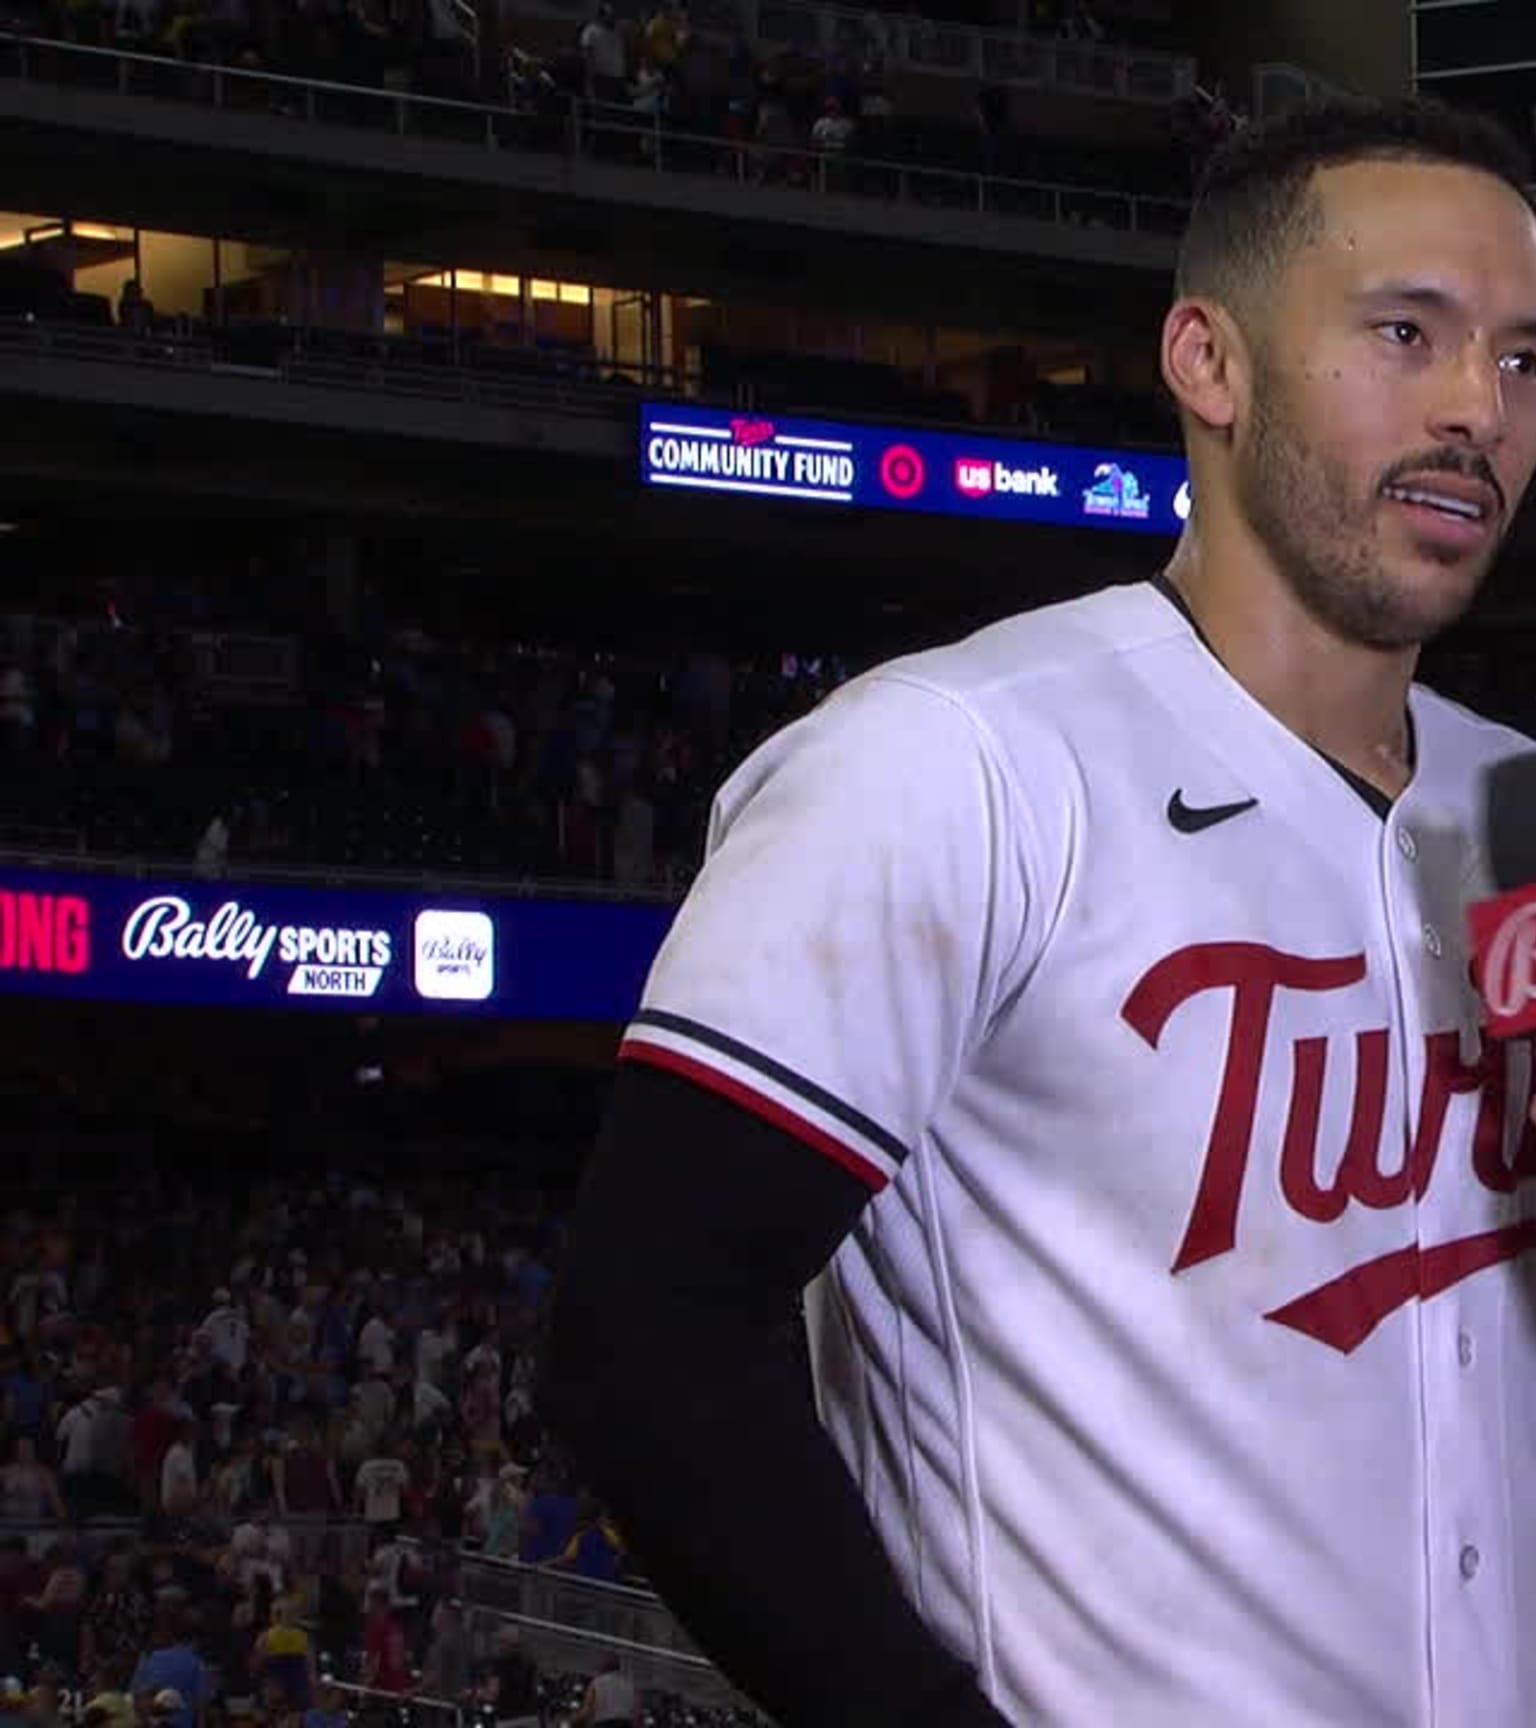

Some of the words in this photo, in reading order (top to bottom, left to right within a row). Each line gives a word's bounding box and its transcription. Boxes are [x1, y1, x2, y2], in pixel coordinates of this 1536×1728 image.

[649, 437, 789, 481] COMMUNITY
[794, 452, 854, 486] FUND
[958, 464, 993, 490] us
[994, 461, 1059, 497] bank
[121, 896, 278, 980] Bally
[279, 927, 392, 967] SPORTS
[303, 968, 368, 993] NORTH
